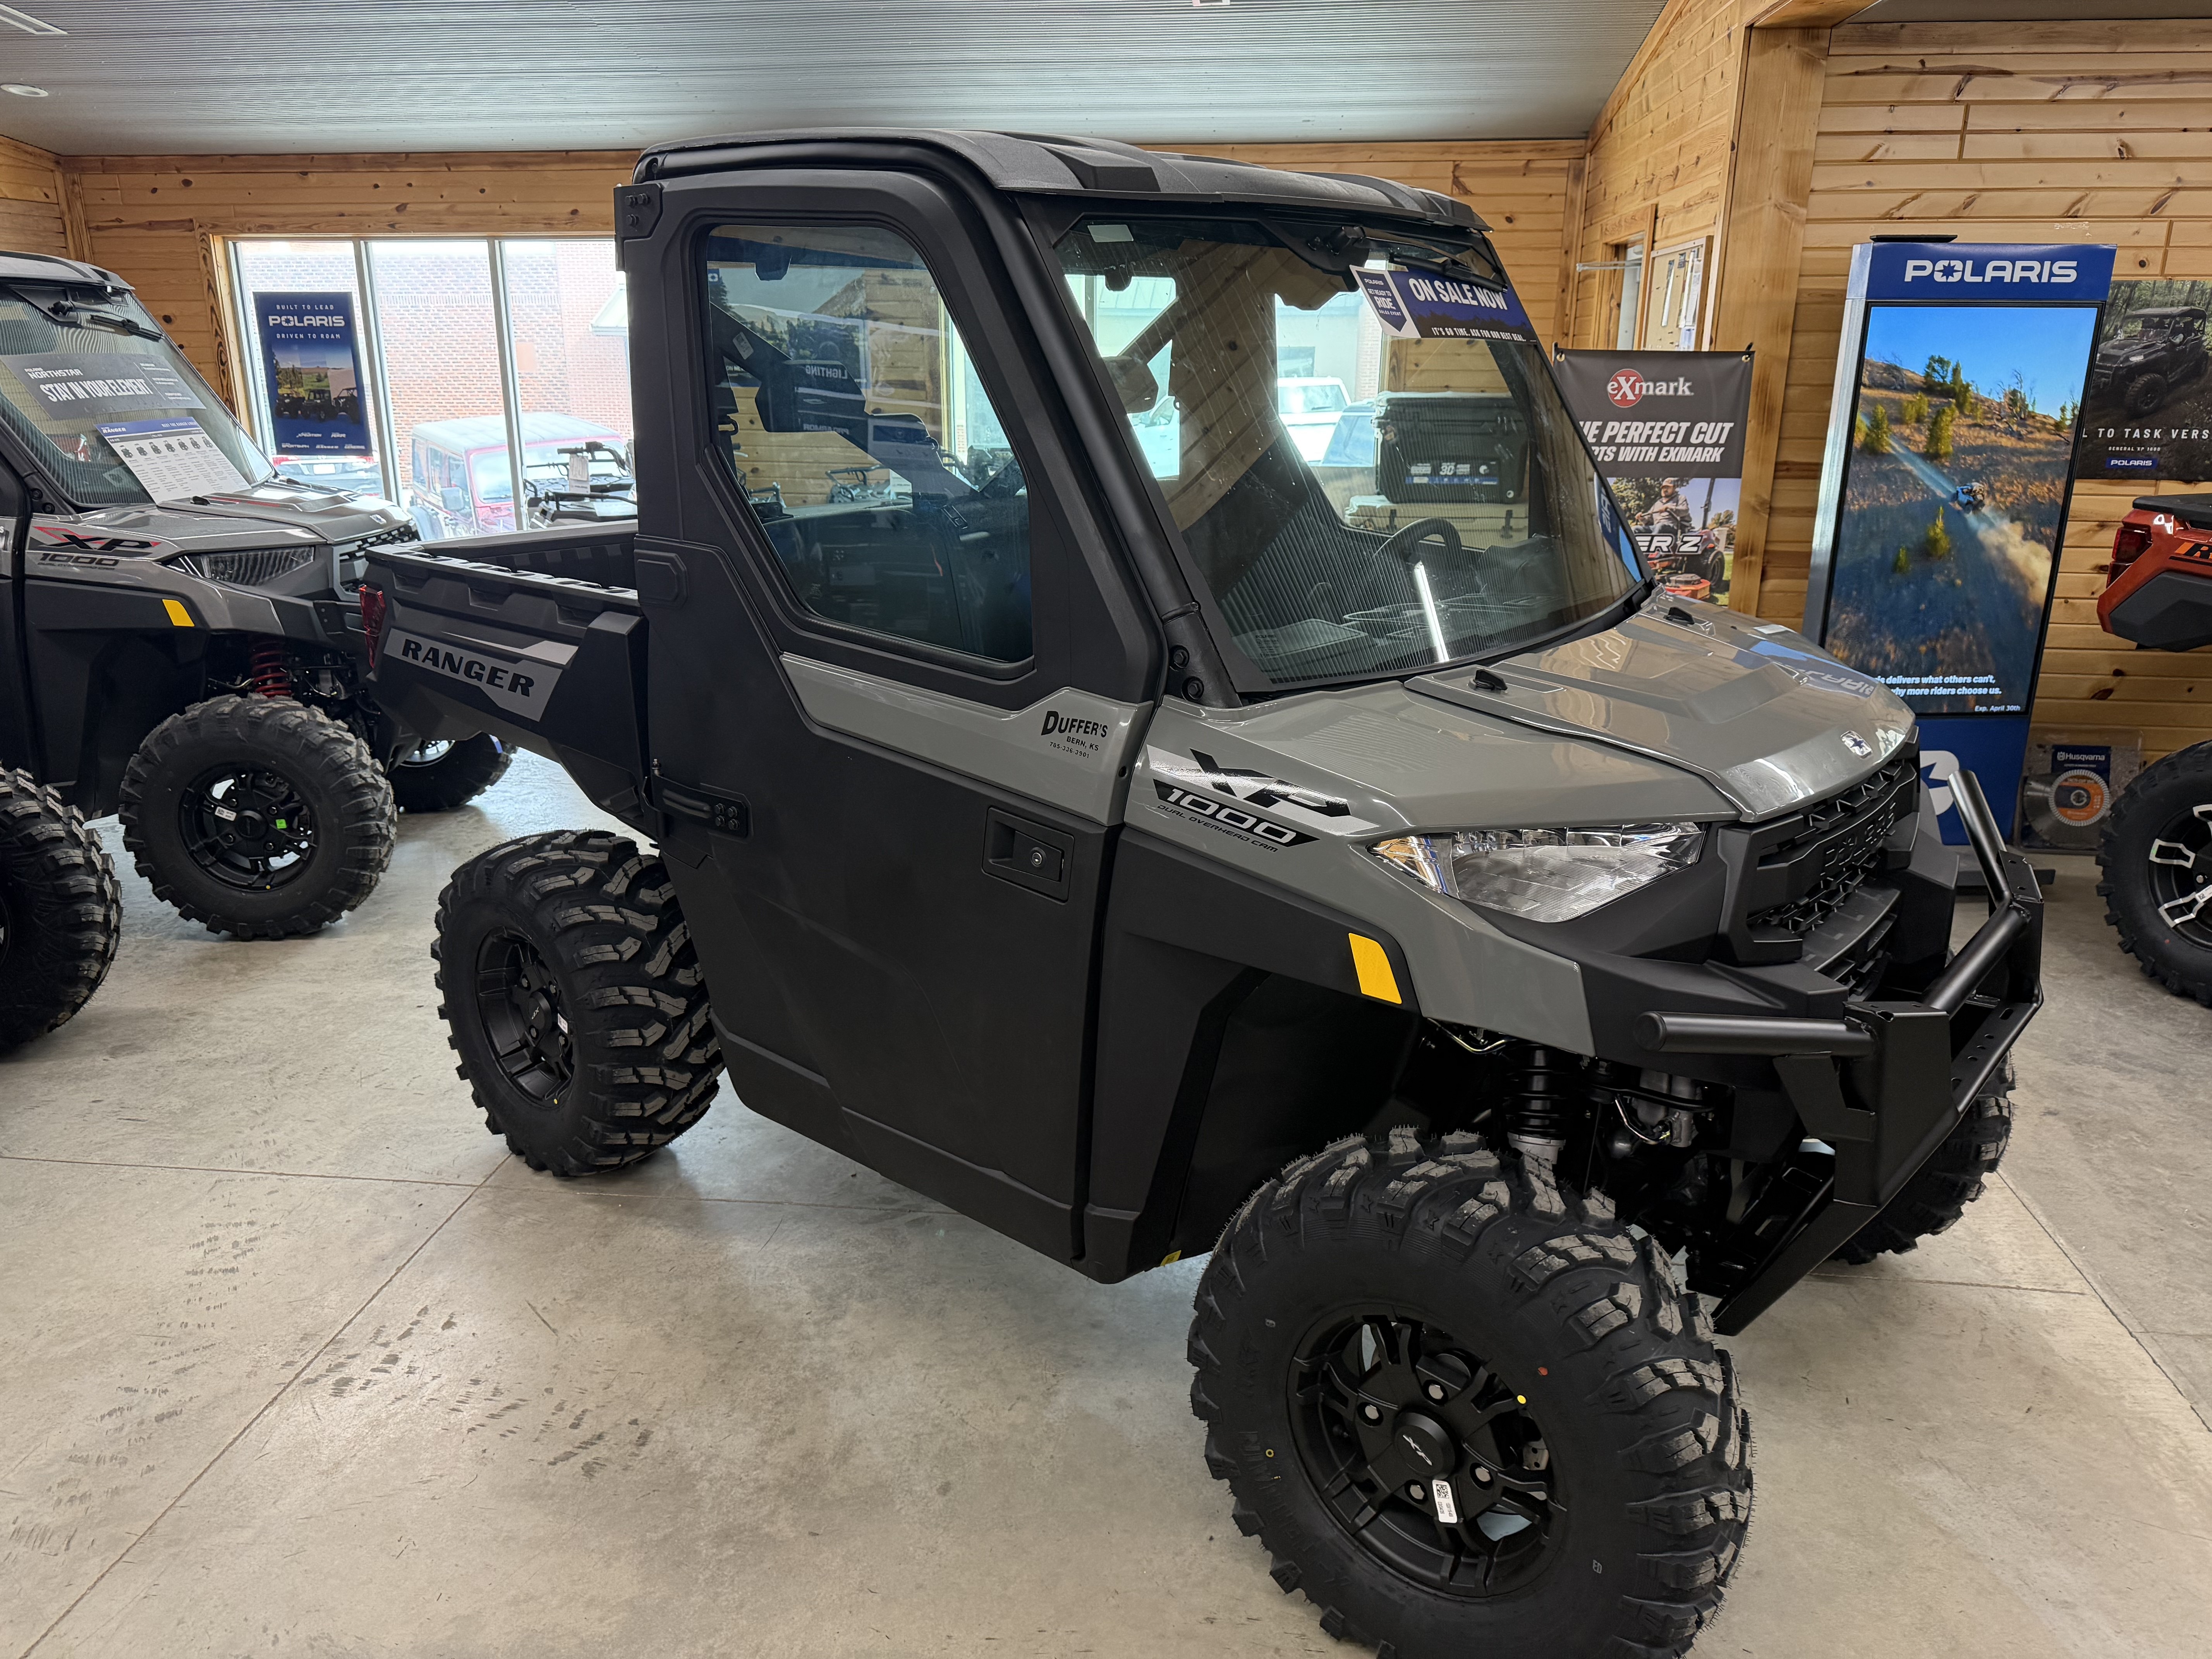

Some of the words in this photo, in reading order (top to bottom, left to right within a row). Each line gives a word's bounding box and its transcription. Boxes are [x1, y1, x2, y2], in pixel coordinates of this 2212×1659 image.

[1904, 259, 2078, 283] POLARIS
[1408, 278, 1438, 302] ON
[1437, 280, 1477, 306] SALE
[1475, 287, 1508, 310] NOW
[268, 316, 345, 327] POLARIS
[1432, 327, 1445, 336] IT'S
[1445, 328, 1454, 336] GO
[1453, 328, 1470, 336] TIME.
[1470, 329, 1481, 337] ASK
[1480, 330, 1491, 338] FOR
[1490, 331, 1501, 339] OUR
[1500, 332, 1512, 340] BEST
[1511, 333, 1527, 342] DEAL.
[27, 369, 83, 379] NORTHSTAR
[40, 383, 76, 402] STAY
[67, 381, 89, 400] IN
[81, 380, 117, 398] YOUR
[106, 378, 154, 396] ELEMENT
[1601, 421, 1691, 443] PERFECT
[1690, 422, 1734, 444] CUT
[2098, 428, 2115, 438] TO
[2124, 428, 2162, 439] TASK
[2171, 429, 2212, 439] VERS
[1618, 447, 1659, 462] WITH
[1658, 447, 1725, 462] EXMARK
[1439, 465, 1455, 476] 30
[46, 534, 154, 551] XP
[2183, 542, 2212, 560] R
[40, 553, 120, 567] 1000
[402, 638, 535, 698] RANGER
[1886, 675, 1920, 684] delivers
[1921, 675, 1943, 684] what
[1944, 675, 1972, 684] others
[1973, 675, 1996, 684] can't,
[1930, 687, 1956, 695] riders
[1957, 687, 1988, 695] choose
[1041, 711, 1108, 738] DUFFER'S
[1066, 736, 1087, 749] BERN,
[1089, 743, 1099, 751] KS
[2065, 753, 2106, 761] Husqvarna
[1190, 748, 1352, 817] XP
[1167, 788, 1297, 844] 1000
[1157, 804, 1185, 819] DUAL
[1190, 817, 1251, 842] OVERHEAD
[1252, 839, 1279, 853] CAM
